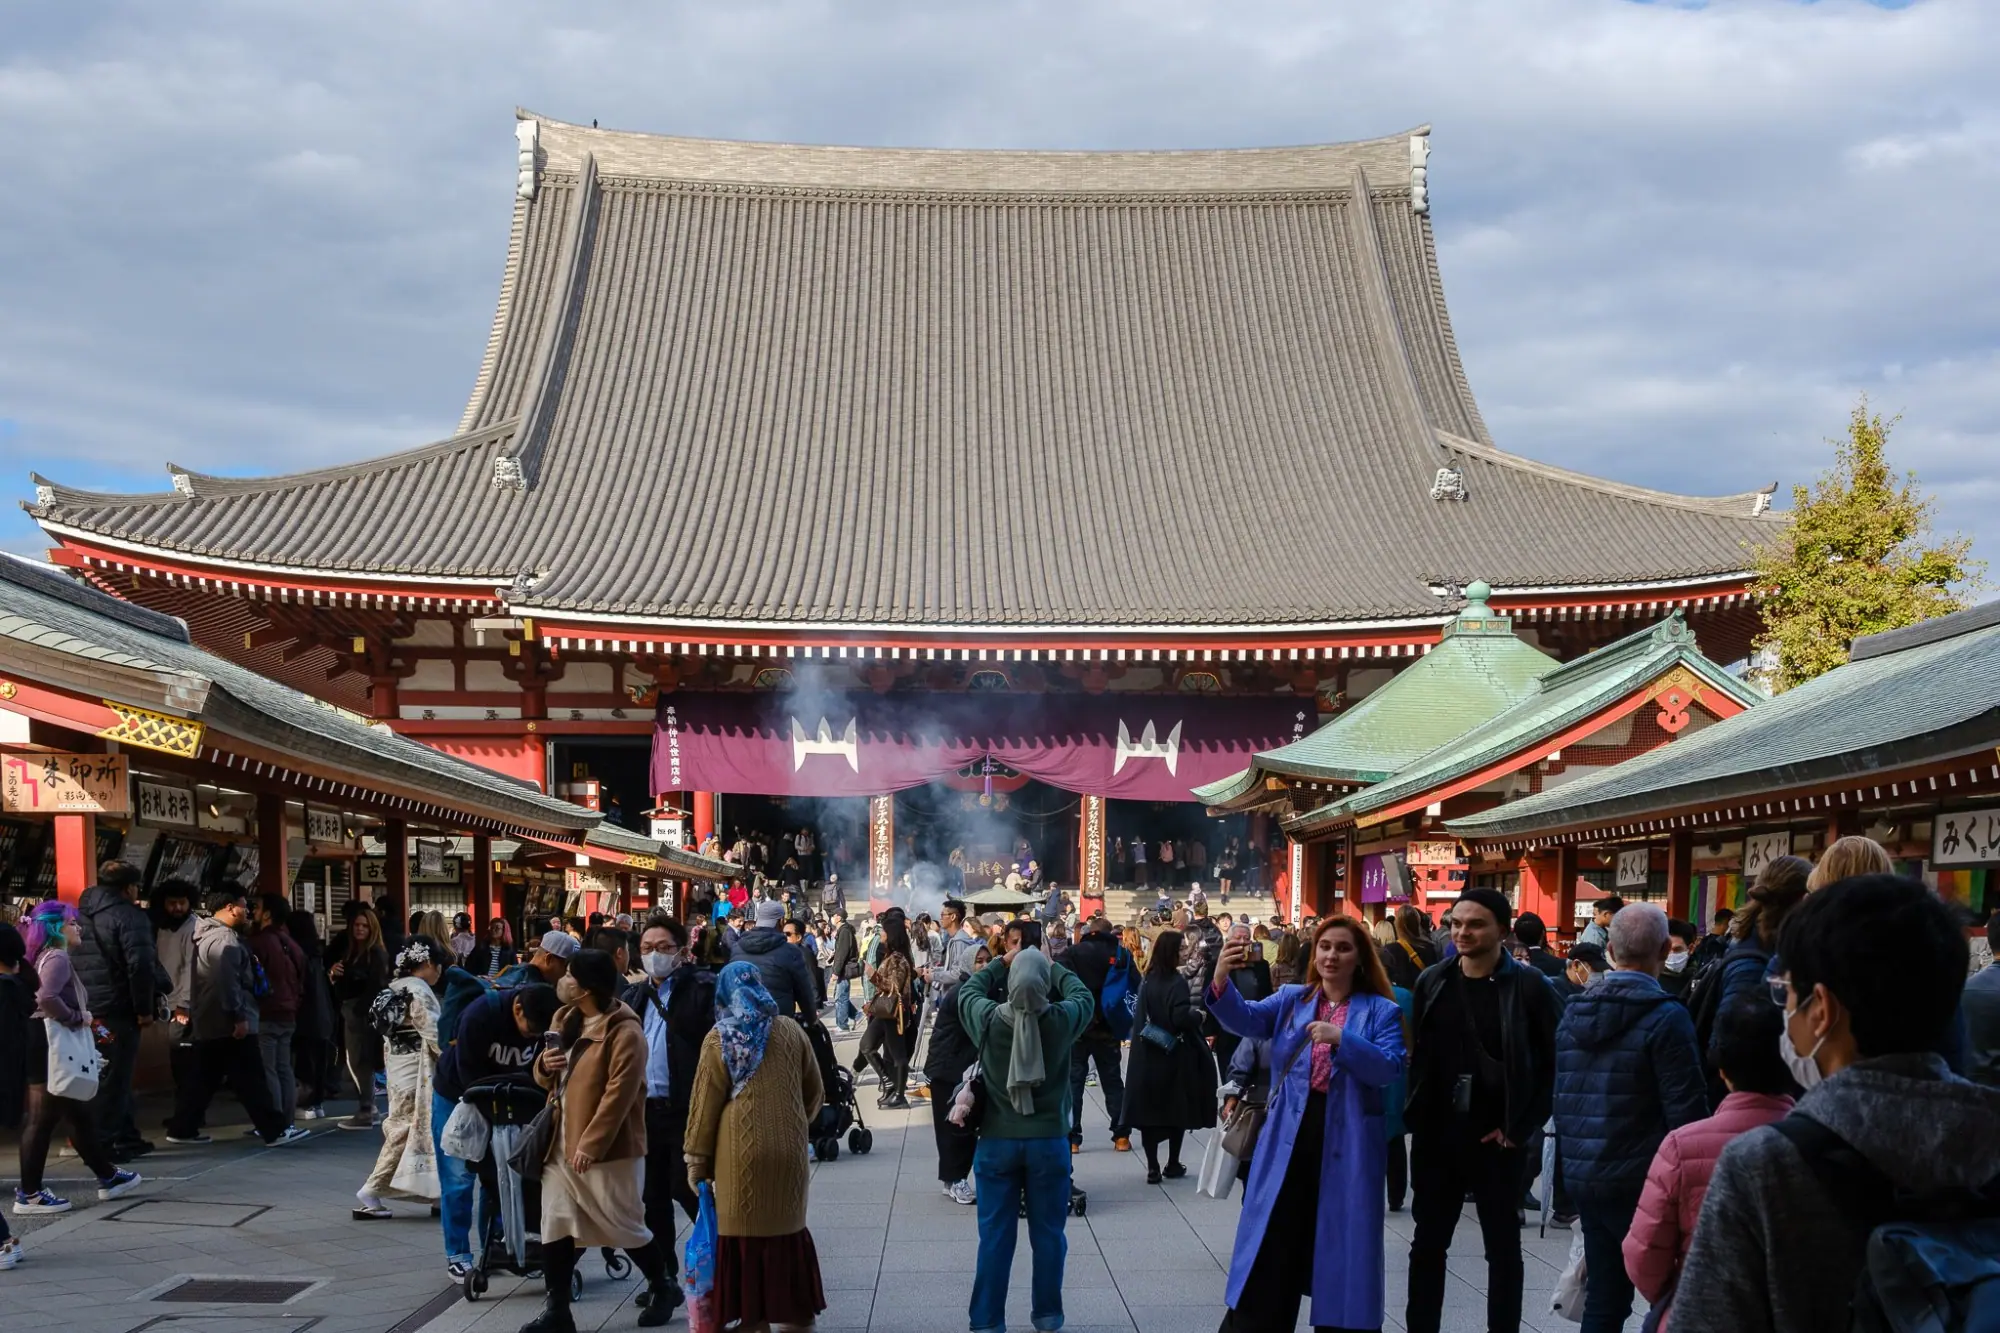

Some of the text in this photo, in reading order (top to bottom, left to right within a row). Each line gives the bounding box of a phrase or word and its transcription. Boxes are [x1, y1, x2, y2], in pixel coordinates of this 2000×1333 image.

[1291, 711, 1306, 743] 令和六
[8, 770, 19, 808] この先左
[43, 756, 120, 790] 朱印所
[141, 786, 191, 822] お札お守
[308, 815, 339, 840] お札お守
[1620, 854, 1647, 880] みくじ
[488, 1040, 539, 1066] NAS
